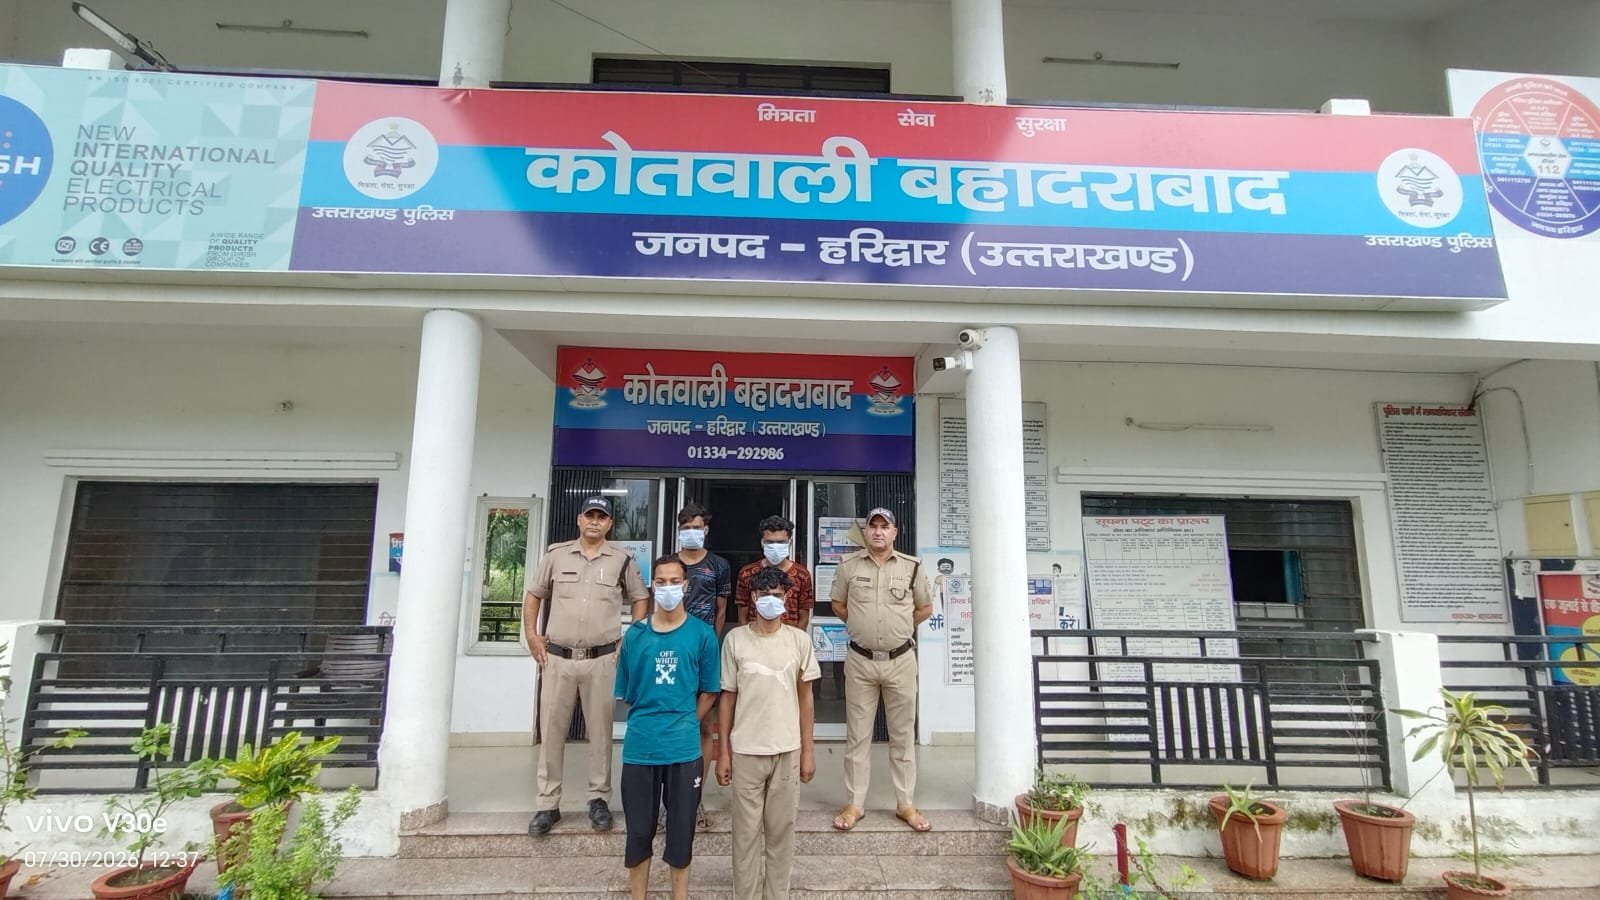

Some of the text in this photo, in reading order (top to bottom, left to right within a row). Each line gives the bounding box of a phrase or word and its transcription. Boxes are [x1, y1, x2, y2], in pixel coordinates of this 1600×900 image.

[757, 103, 1067, 137] मित्रता सेवा सुरक्षा
[77, 124, 136, 141] NEW
[73, 142, 276, 164] INTERNATIONAL
[70, 160, 183, 178] QUALITY
[525, 131, 1290, 215] कोतवाली बहादराबाद
[1538, 165, 1561, 175] 112
[66, 178, 222, 198] ELECTRICAL
[63, 196, 205, 216] PRODUCTS
[312, 204, 456, 226] उत्तराखण्ड पुलिस
[1364, 232, 1494, 253] उत्तराखण्ड पुलिस
[632, 231, 770, 259] जनपद
[818, 227, 949, 267] हरिद्वार
[961, 231, 1195, 282] (उत्तराखण्ड)
[623, 363, 854, 412] कोतवाली बहादराबाद
[647, 419, 691, 435] जनपद
[706, 416, 747, 438] हरिद्वार
[687, 445, 784, 460] 01334-292986
